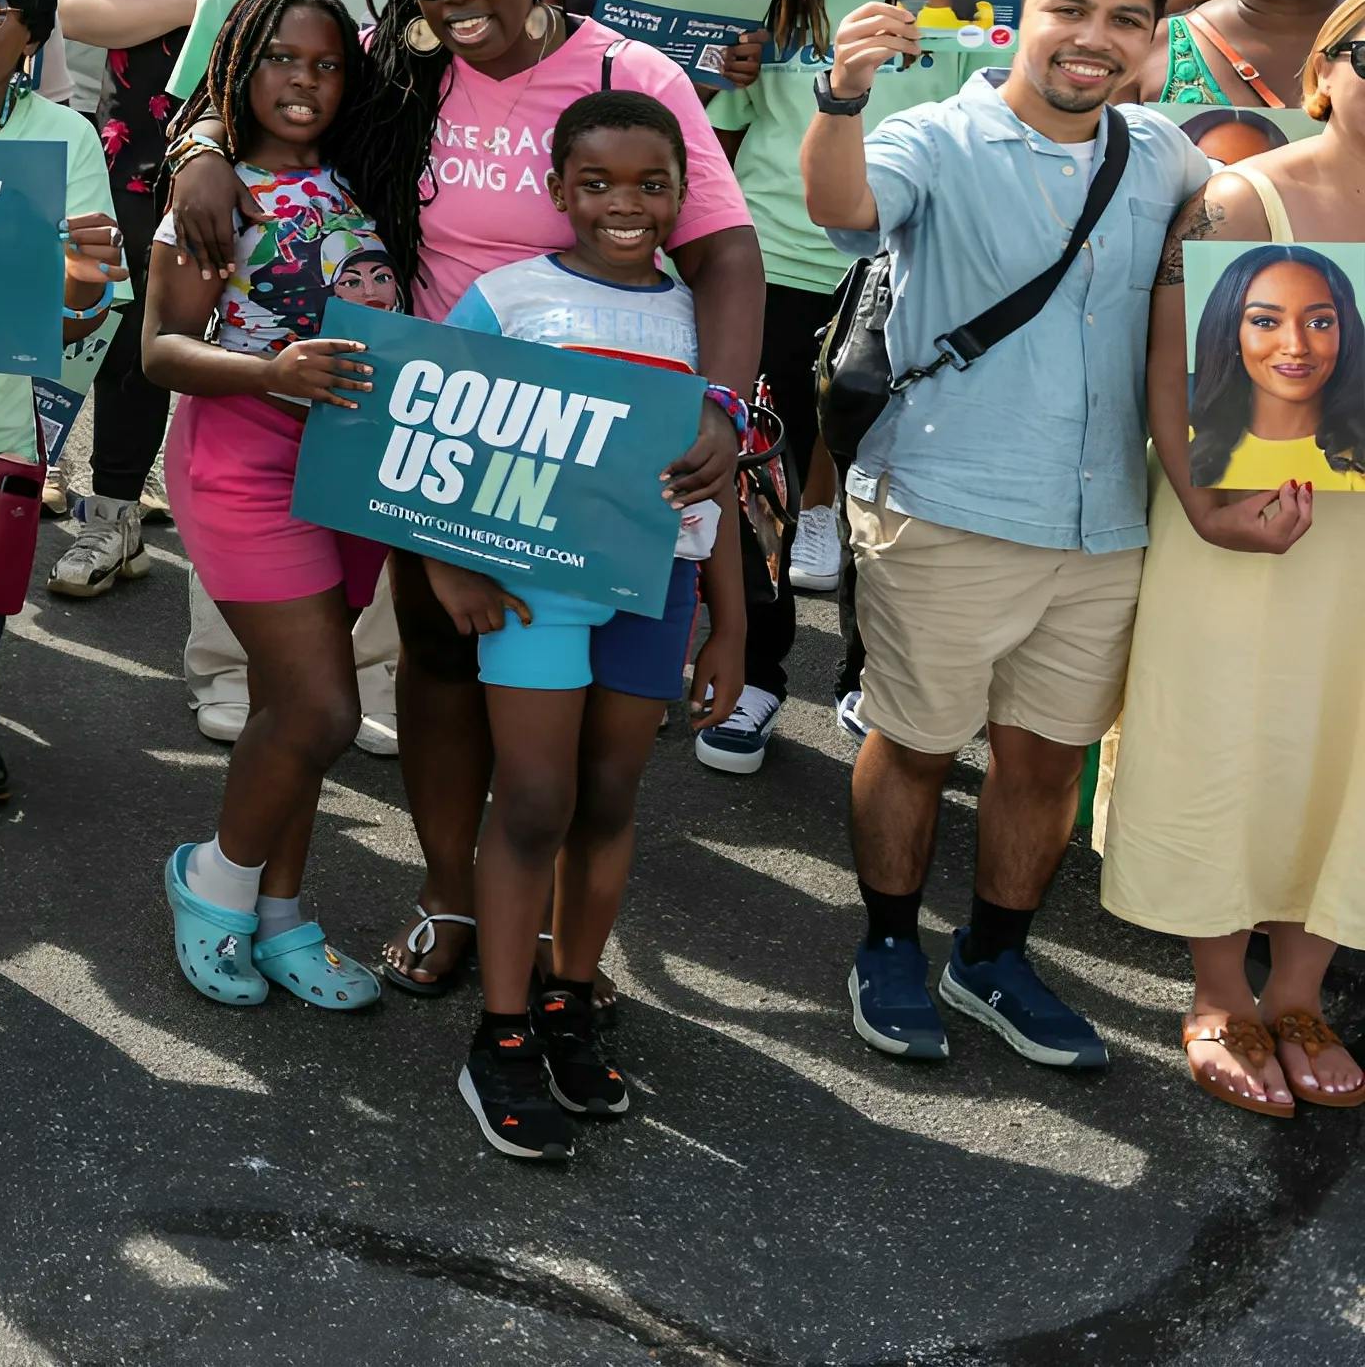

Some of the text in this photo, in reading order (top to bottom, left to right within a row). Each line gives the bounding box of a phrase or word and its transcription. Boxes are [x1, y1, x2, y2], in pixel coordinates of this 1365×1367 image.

[388, 359, 631, 467] COUNT
[378, 425, 561, 531] US IN.
